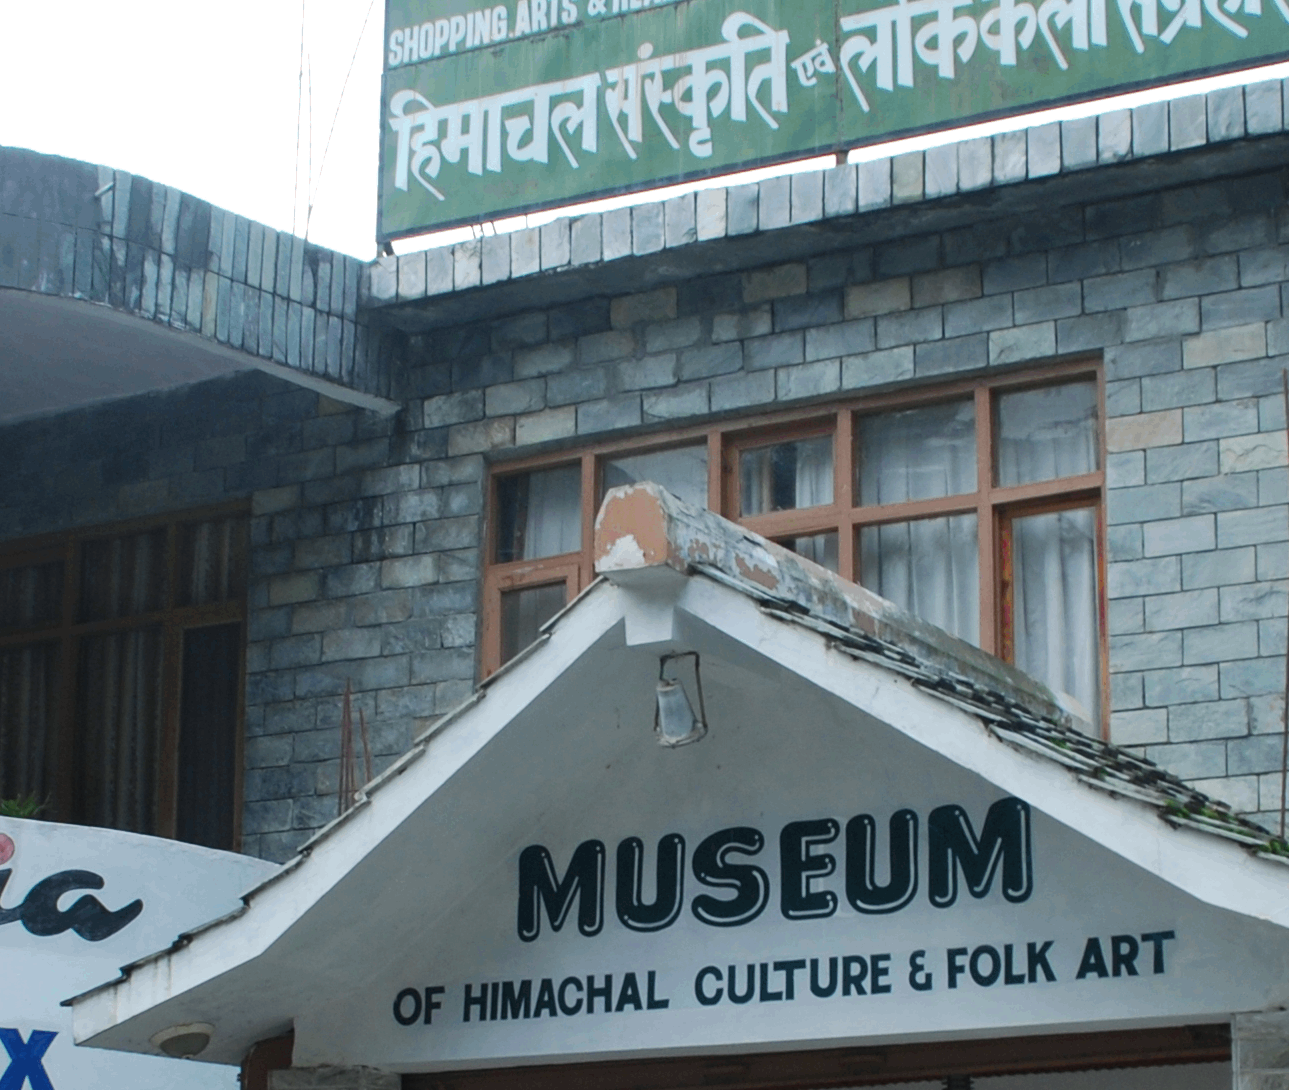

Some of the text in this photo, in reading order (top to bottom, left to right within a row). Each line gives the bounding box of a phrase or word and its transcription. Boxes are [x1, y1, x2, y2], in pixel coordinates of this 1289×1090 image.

[389, 72, 600, 200] हिमाचल
[516, 797, 1033, 943] MUSEUM
[393, 930, 1176, 1027] OF HIMACHAL CULTURE & FOLK ART
